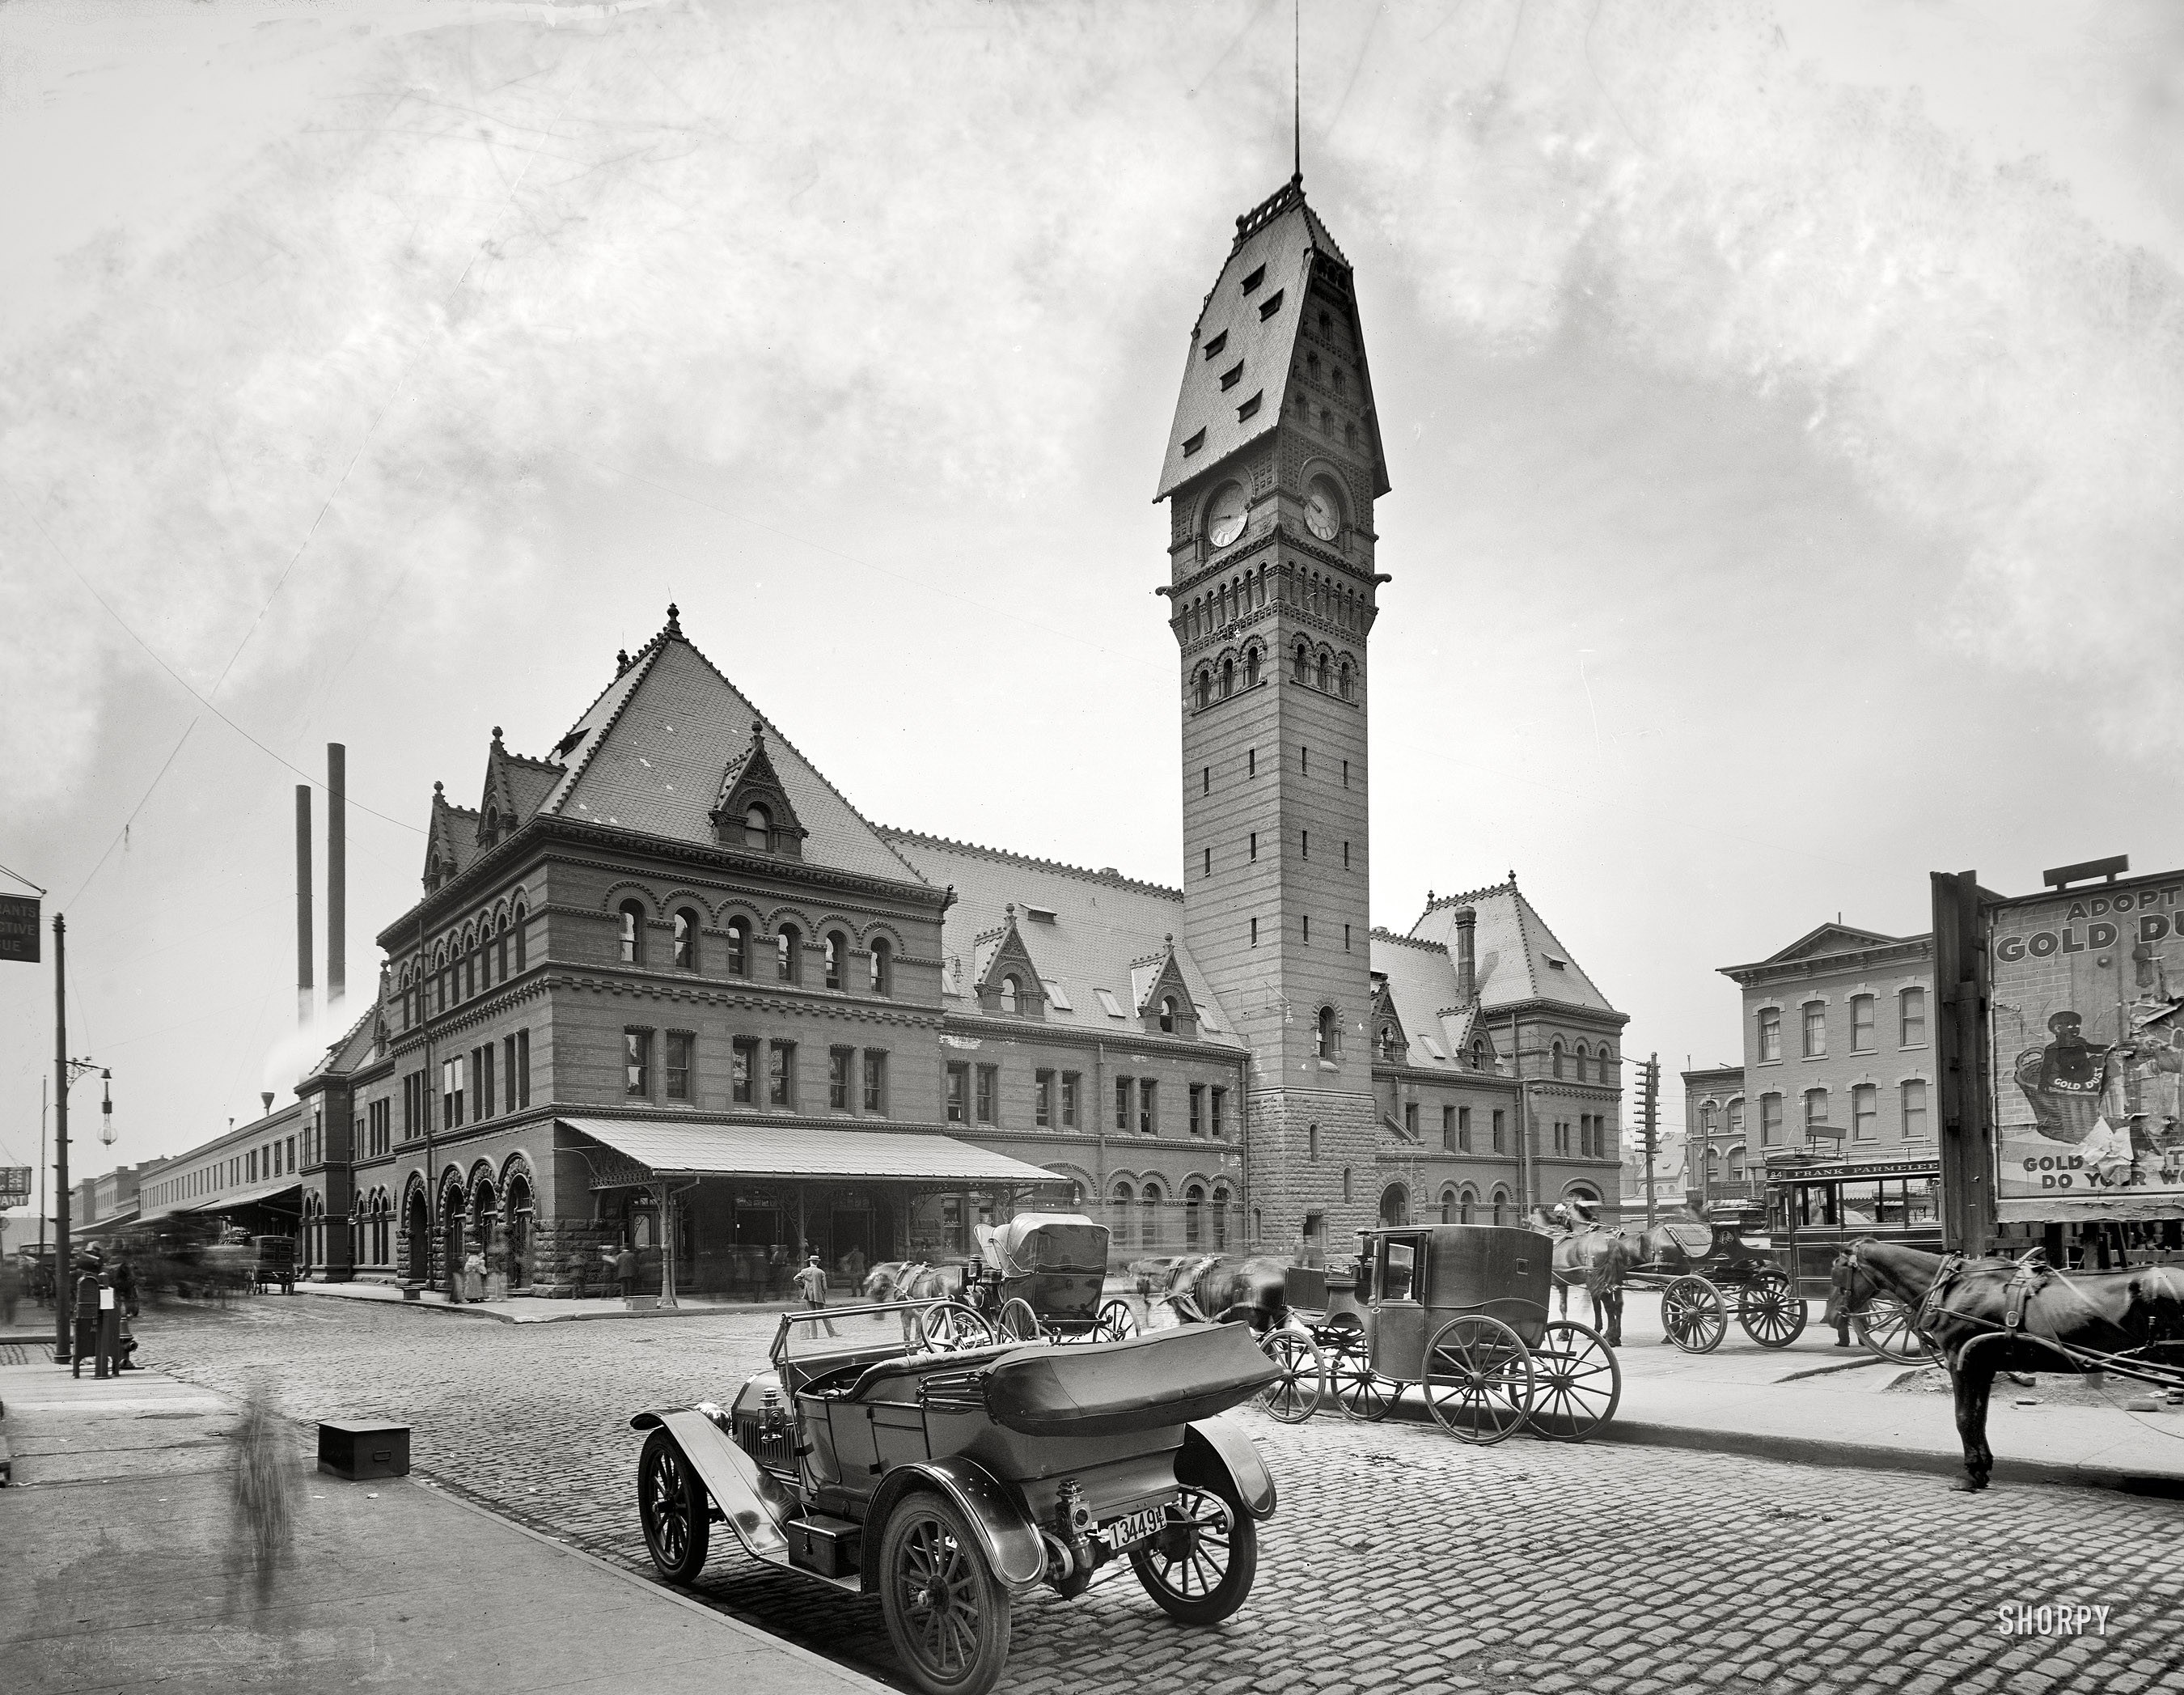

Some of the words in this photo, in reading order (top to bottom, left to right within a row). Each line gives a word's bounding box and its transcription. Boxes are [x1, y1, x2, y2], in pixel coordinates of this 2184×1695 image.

[0, 905, 36, 917] ANTS
[2064, 884, 2183, 922] ADOPT
[0, 939, 22, 951] UE
[1996, 922, 2119, 964] GOLD
[2055, 1078, 2081, 1090] GOLD
[2085, 1066, 2103, 1089] DUST
[1793, 1167, 1844, 1177] FRANK
[1853, 1162, 1938, 1174] PARMELEE
[2023, 1155, 2084, 1172] GOLD
[2042, 1173, 2073, 1189] DO
[2158, 1169, 2184, 1185] W
[1111, 1510, 1158, 1547] 13449
